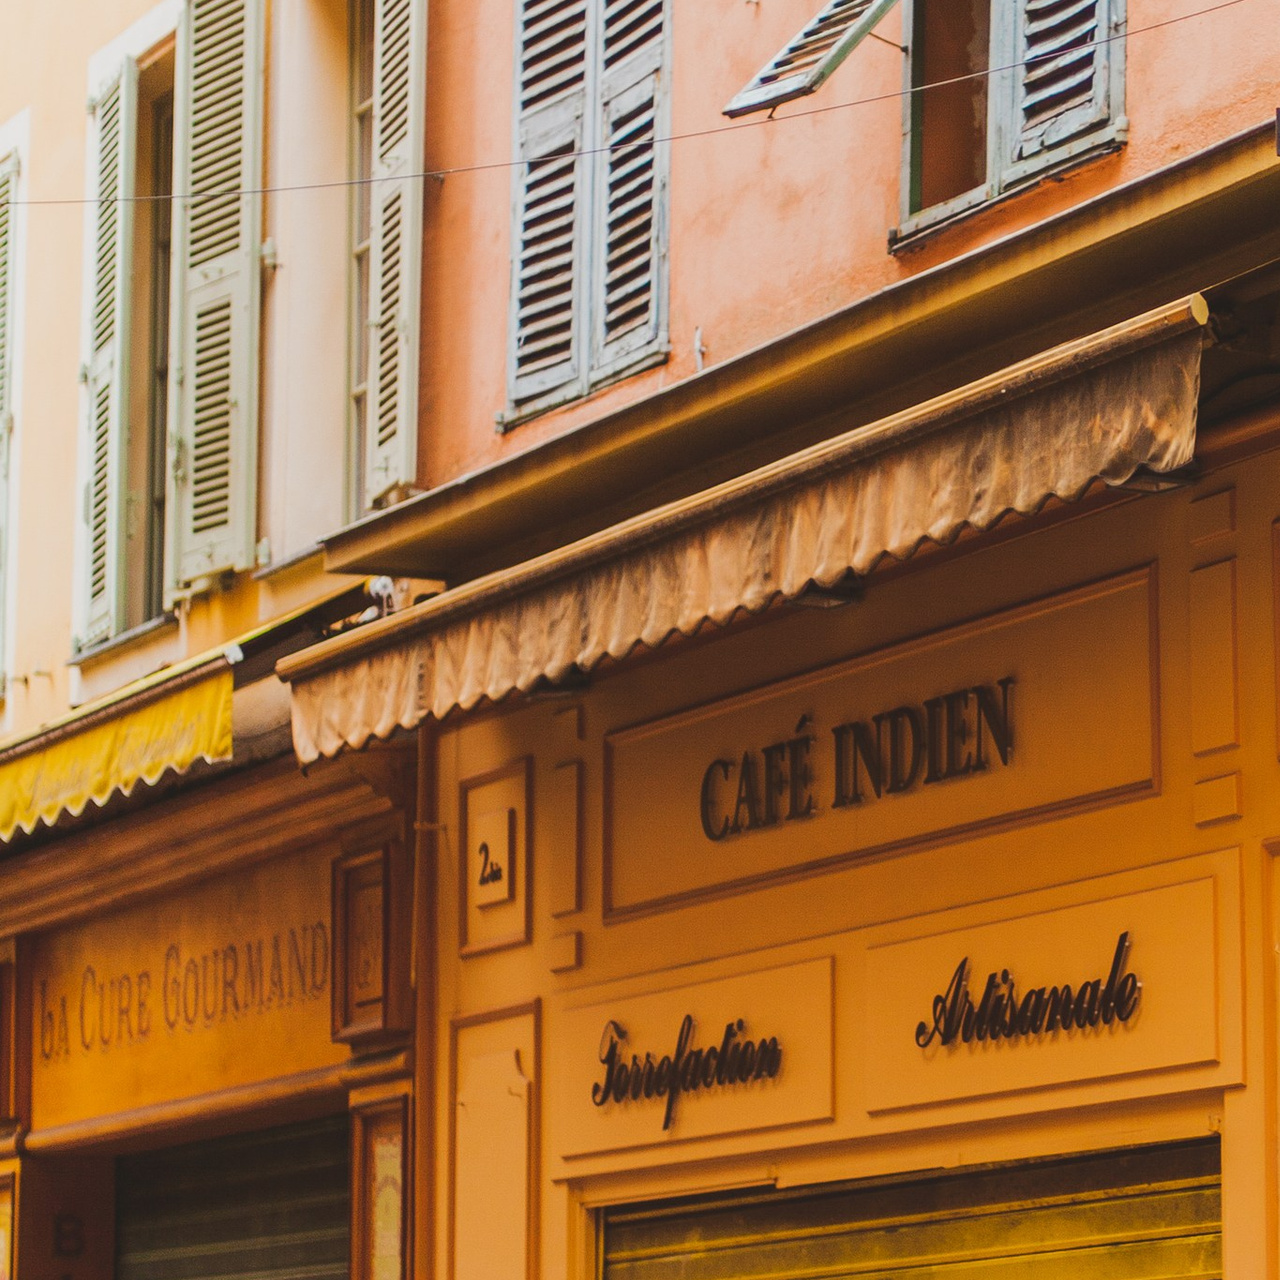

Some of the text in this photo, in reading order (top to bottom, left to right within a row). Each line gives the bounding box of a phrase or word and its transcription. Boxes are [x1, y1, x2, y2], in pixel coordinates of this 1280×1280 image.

[699, 676, 1017, 842] CAFÉ INDIEN
[914, 930, 1140, 1049] Artisanale
[591, 1013, 783, 1131] Torrefaction
